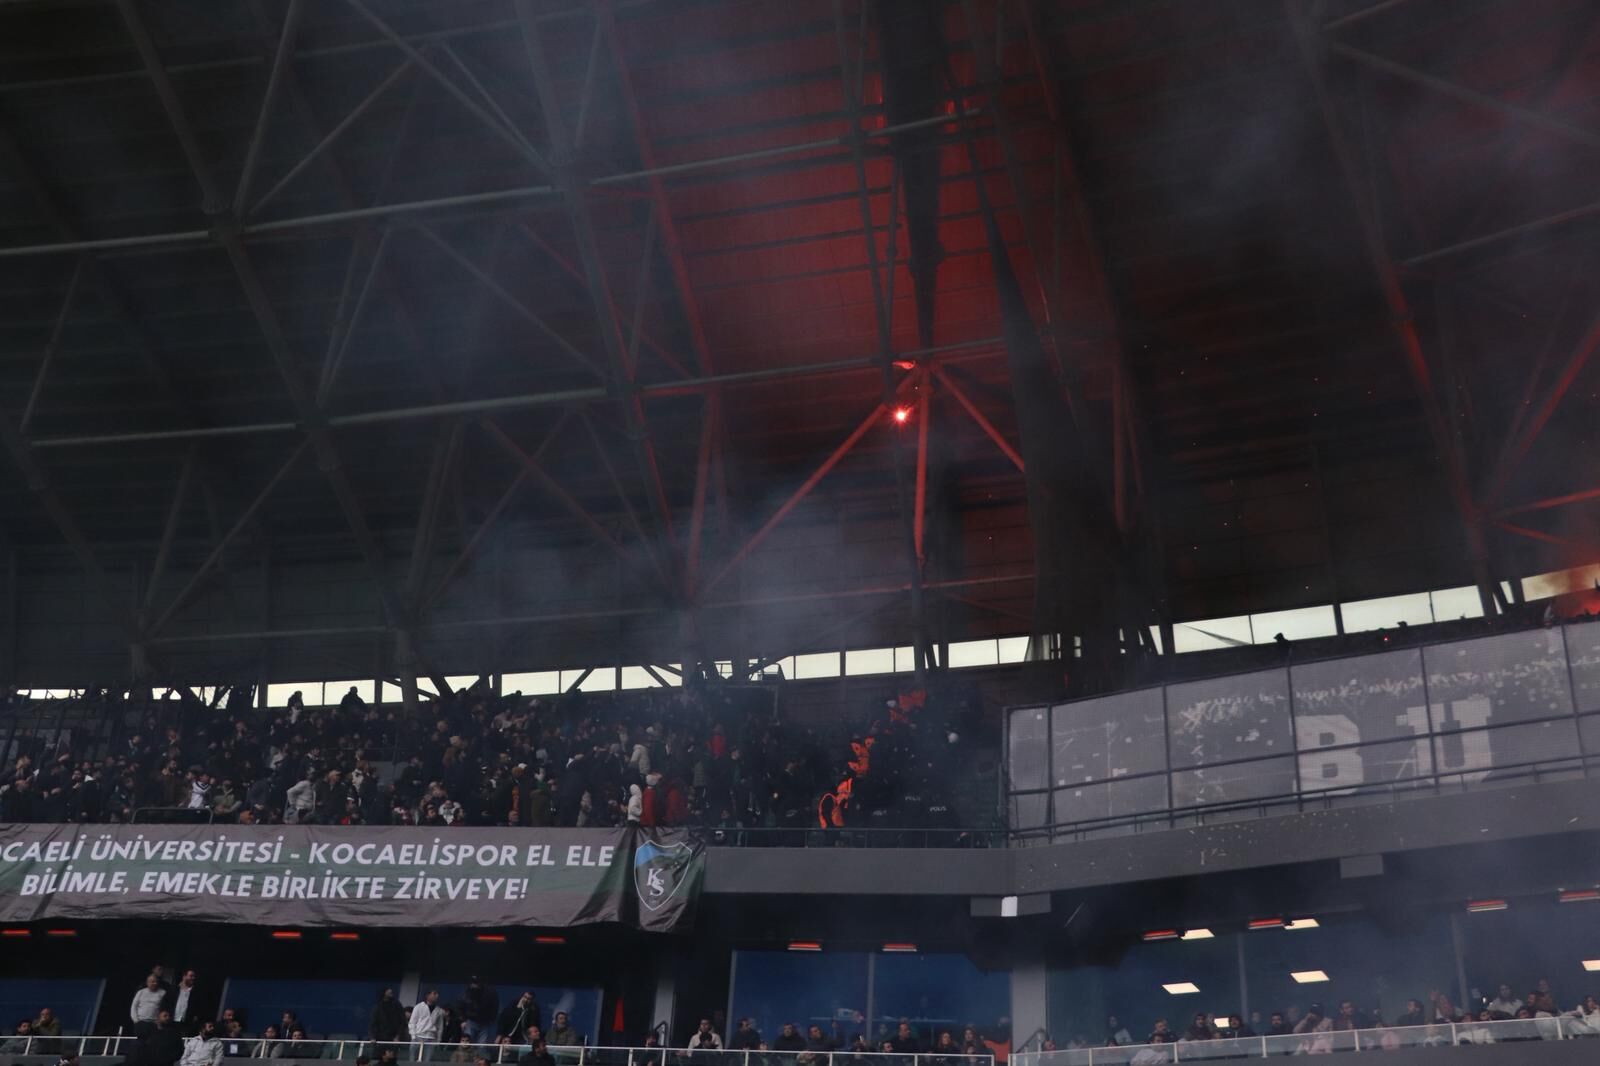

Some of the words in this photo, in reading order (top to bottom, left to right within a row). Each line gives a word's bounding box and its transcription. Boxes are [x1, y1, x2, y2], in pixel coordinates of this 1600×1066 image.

[0, 834, 87, 862] CAELİ
[91, 834, 284, 863] ÜNİVERSİTESİ
[308, 838, 518, 866] KOCAELİSPOR
[526, 845, 555, 866] EL
[566, 845, 614, 866] ELE
[20, 865, 129, 896] BİLİMLE,
[139, 871, 254, 897] EMEKLE
[261, 869, 386, 899] BİRLİKTE
[394, 871, 529, 900] ZİRVEYE!
